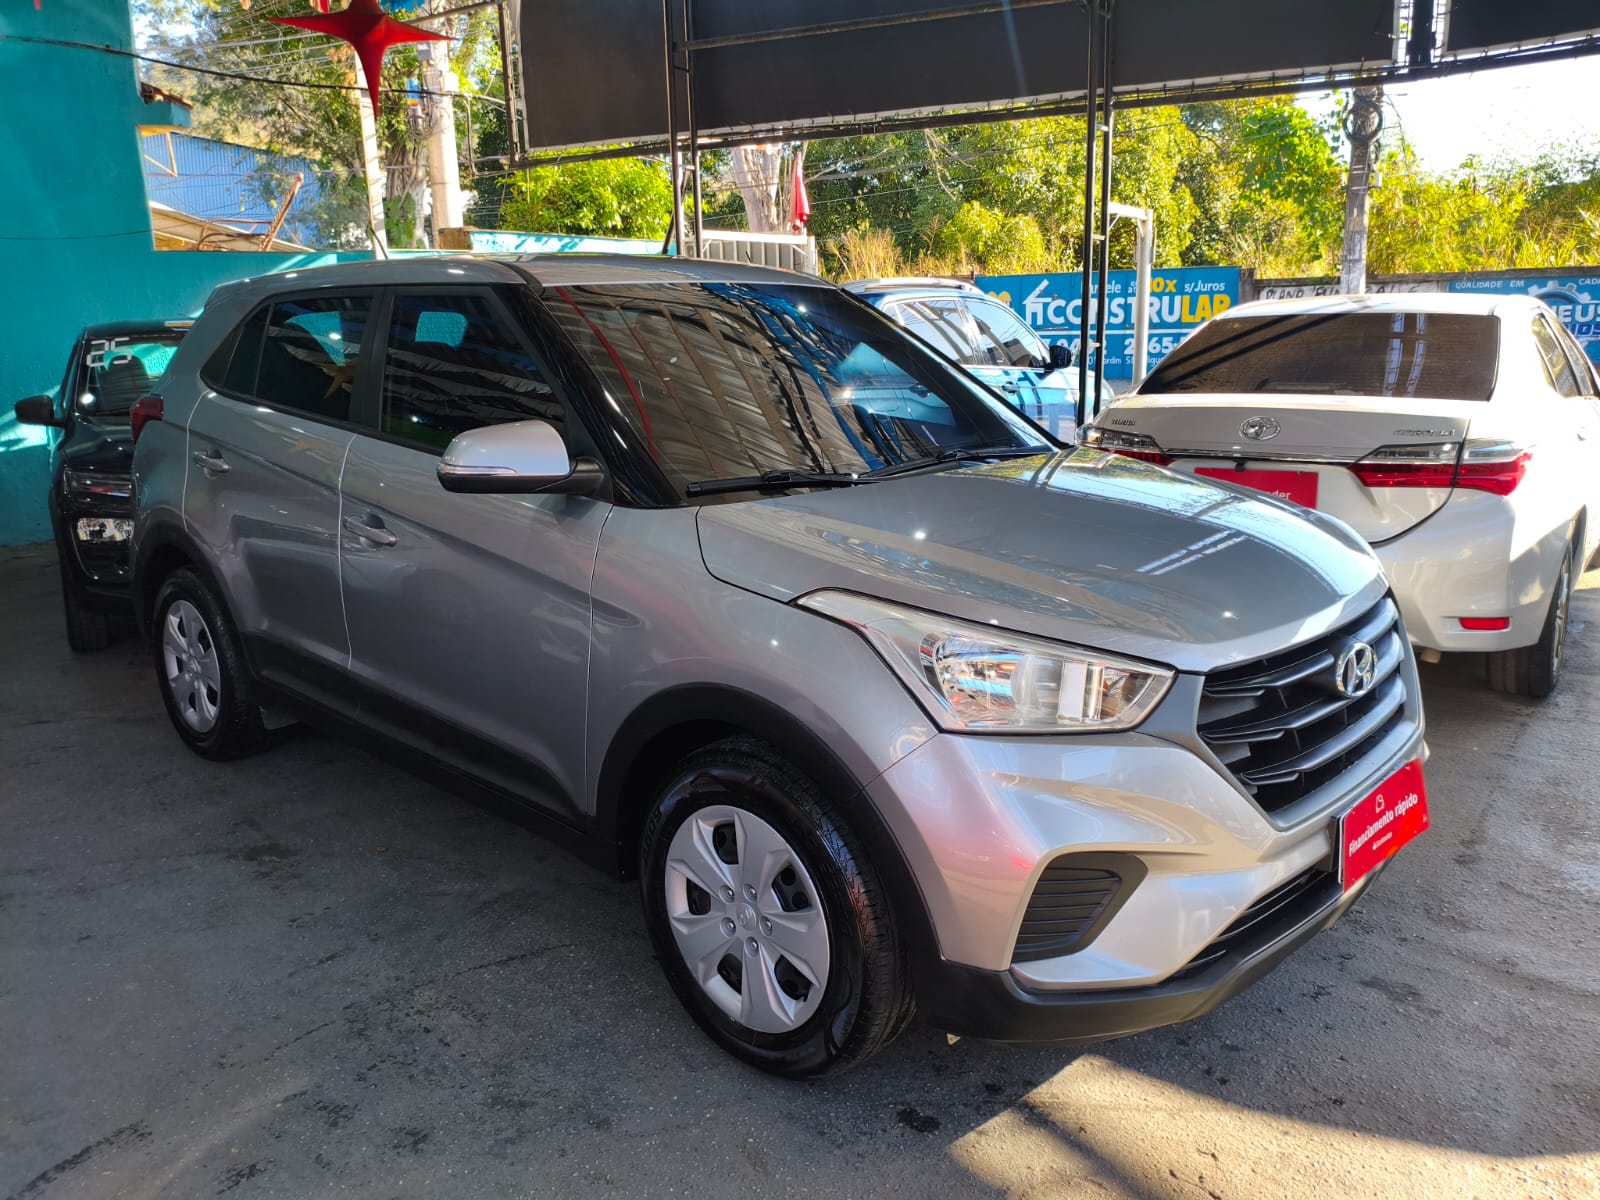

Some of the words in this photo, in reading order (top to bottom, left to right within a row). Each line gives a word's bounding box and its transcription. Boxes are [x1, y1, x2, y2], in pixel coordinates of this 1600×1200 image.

[1184, 280, 1226, 293] s/Juros
[1455, 280, 1503, 289] QUALIDADE
[1509, 280, 1525, 288] EM
[86, 337, 132, 367] 25
[1348, 809, 1395, 857] Financiamento
[1394, 793, 1419, 817] rápido
